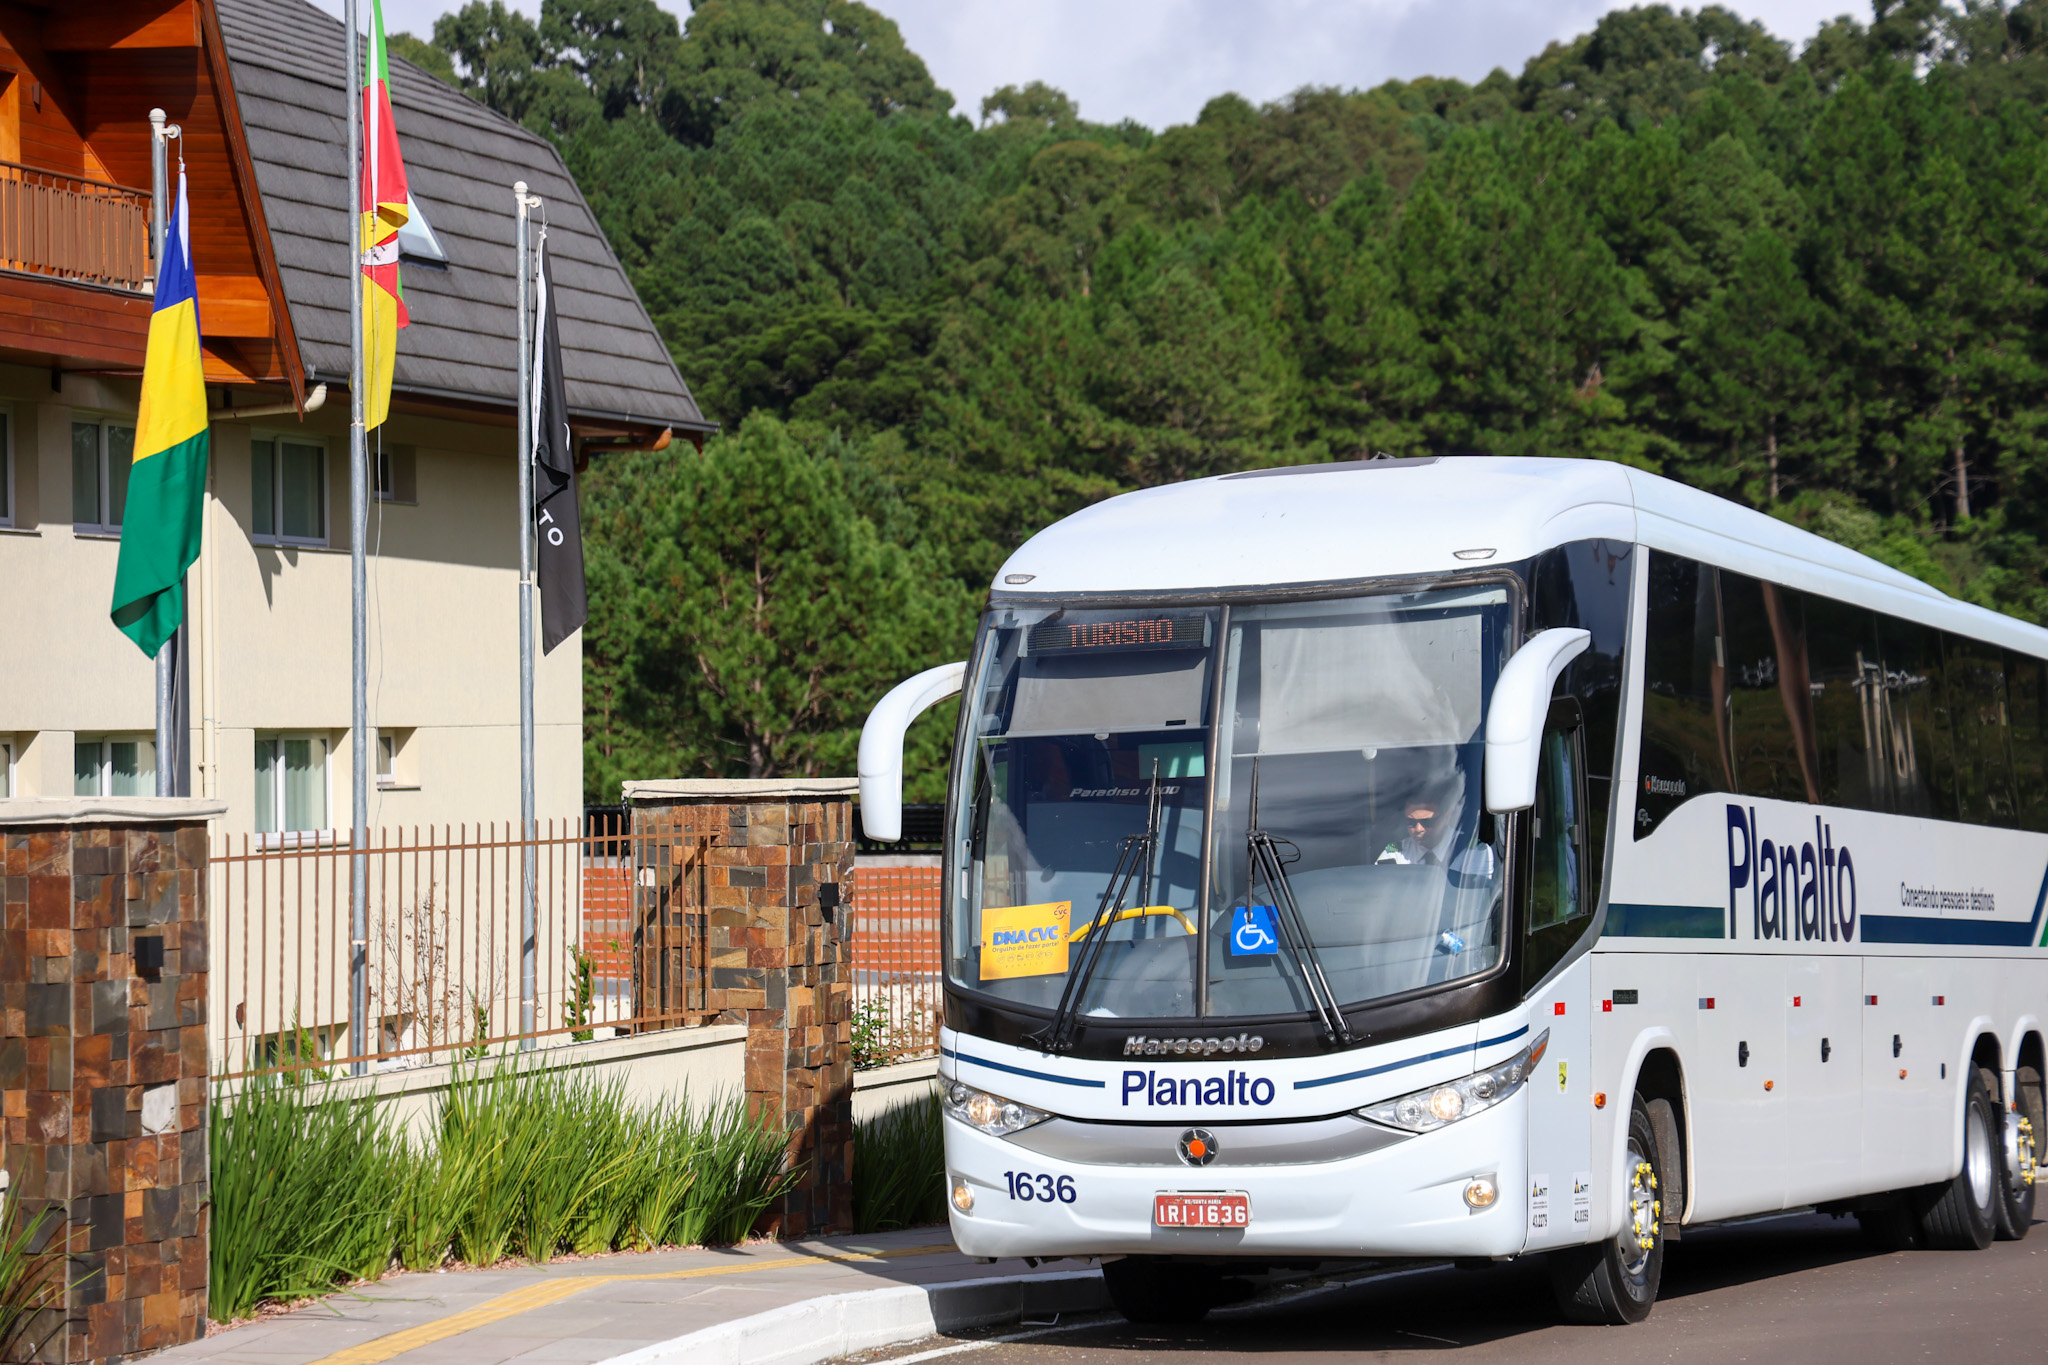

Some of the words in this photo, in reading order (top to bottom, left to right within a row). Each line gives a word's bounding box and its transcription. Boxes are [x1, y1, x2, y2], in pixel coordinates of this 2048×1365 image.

[1068, 619, 1173, 648] TURISMO
[1069, 787, 1140, 798] Paradiso
[1145, 785, 1180, 796] 100
[1726, 804, 1856, 943] Planalto
[1053, 908, 1067, 916] CVC
[1901, 881, 1939, 909] Conectando
[1940, 890, 1965, 915] pessoas
[1123, 1033, 1264, 1056] Marcopolo
[1122, 1070, 1275, 1106] Planalto
[1003, 1171, 1077, 1204] 1636
